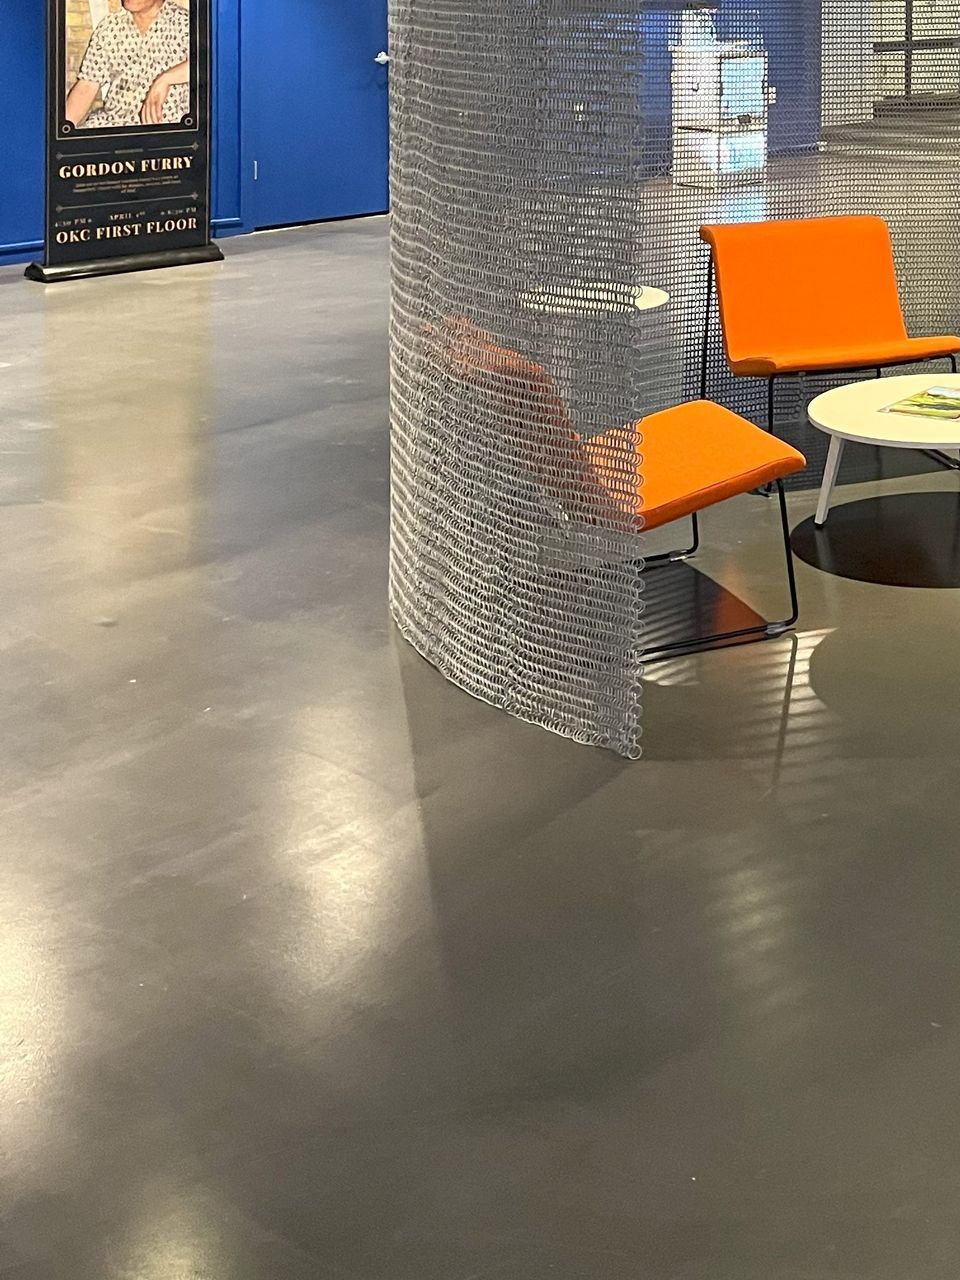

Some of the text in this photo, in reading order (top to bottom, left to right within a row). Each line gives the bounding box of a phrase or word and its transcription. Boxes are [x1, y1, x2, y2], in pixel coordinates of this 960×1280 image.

[59, 156, 194, 179] GORDON FURRY
[109, 212, 132, 221] APRIL
[56, 217, 197, 244] OKC FIRST FLOOR
